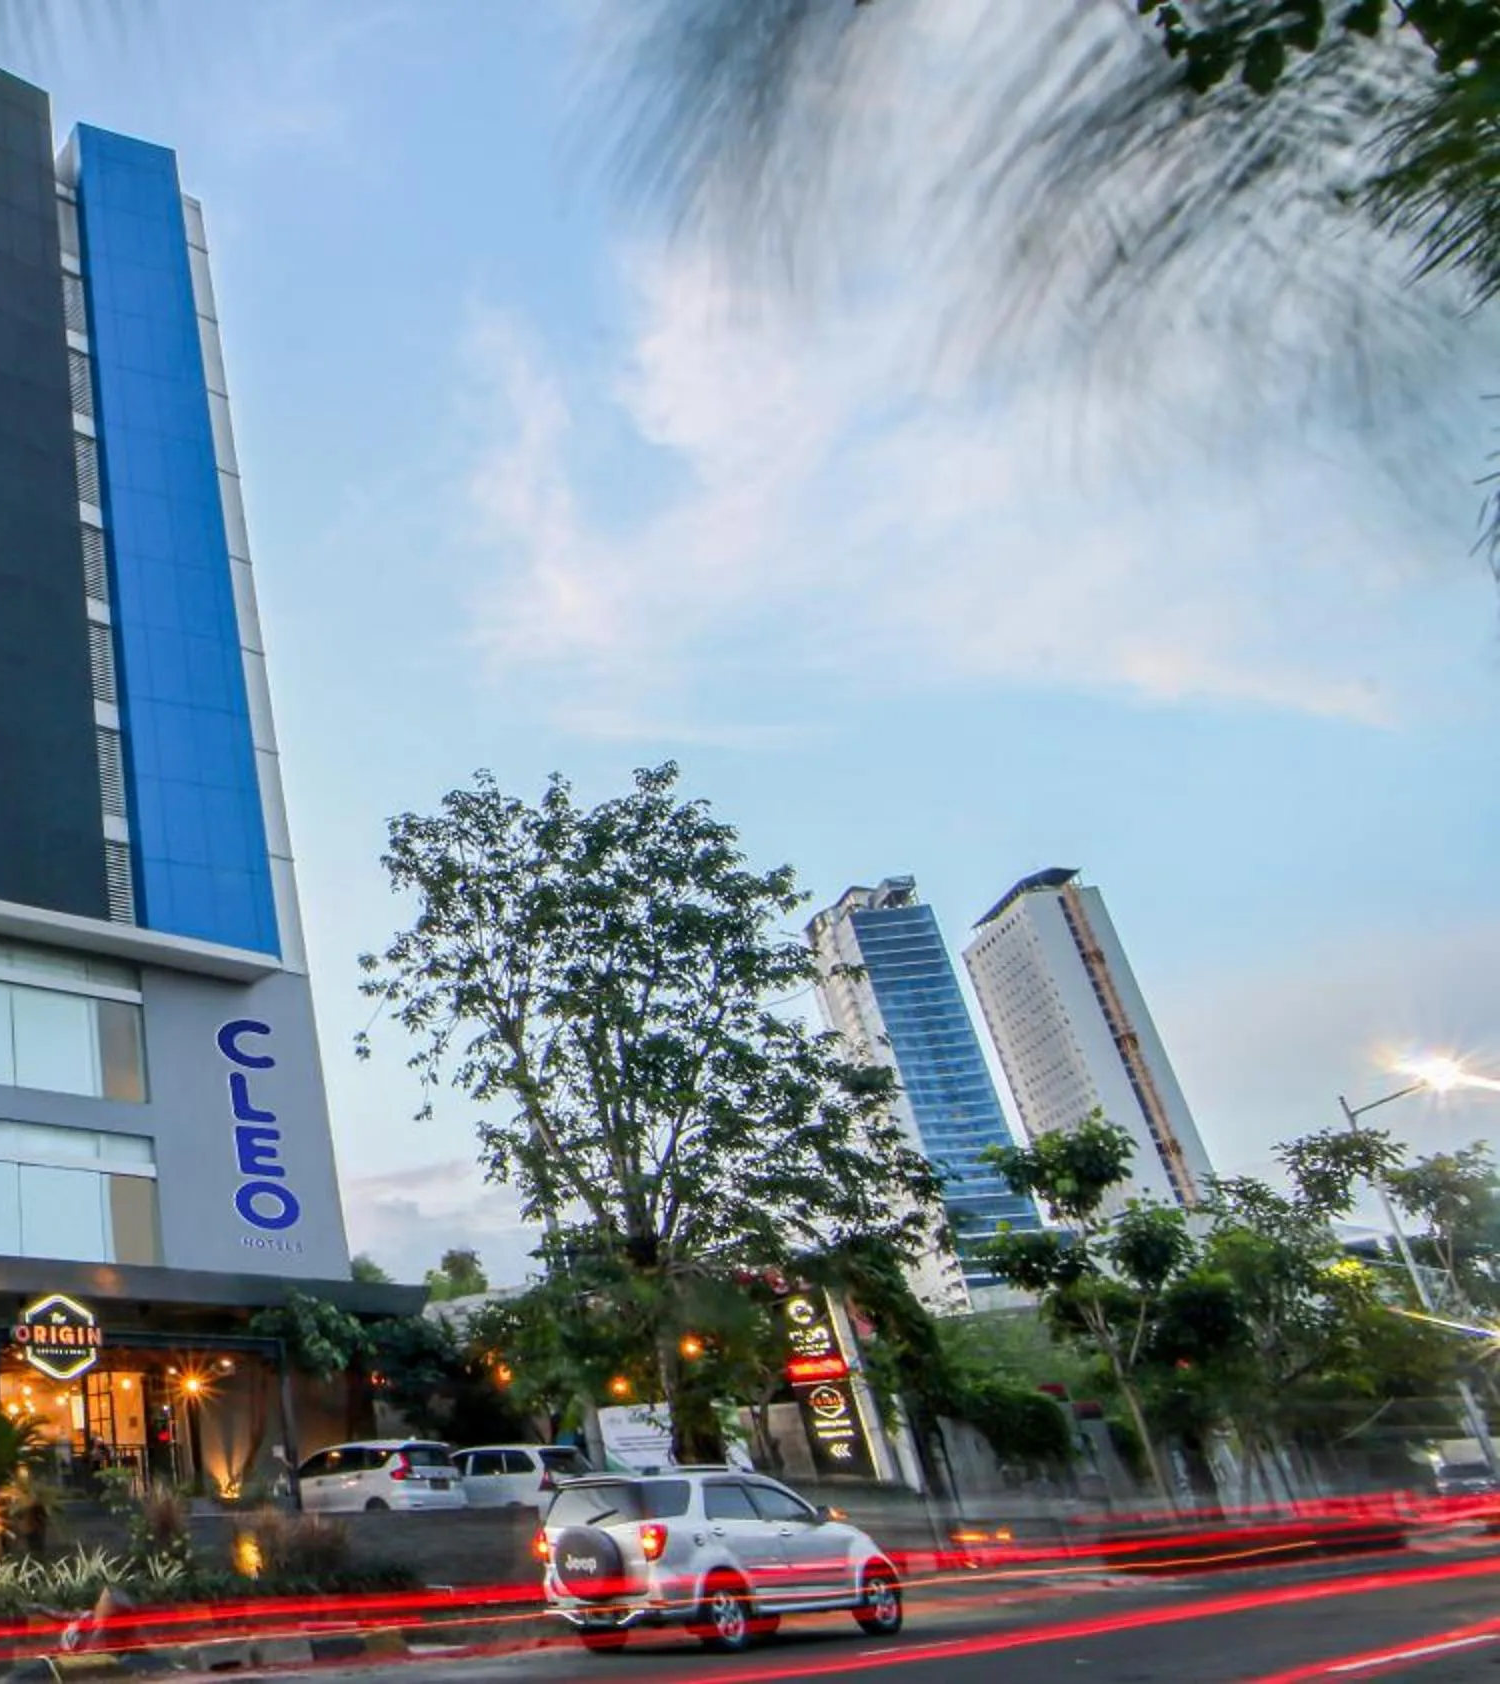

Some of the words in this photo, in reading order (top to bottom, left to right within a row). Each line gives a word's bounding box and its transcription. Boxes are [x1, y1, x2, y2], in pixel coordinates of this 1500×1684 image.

[217, 1019, 299, 1230] CLEO
[15, 1325, 101, 1345] ORIGIN
[565, 1553, 597, 1575] Jeep
